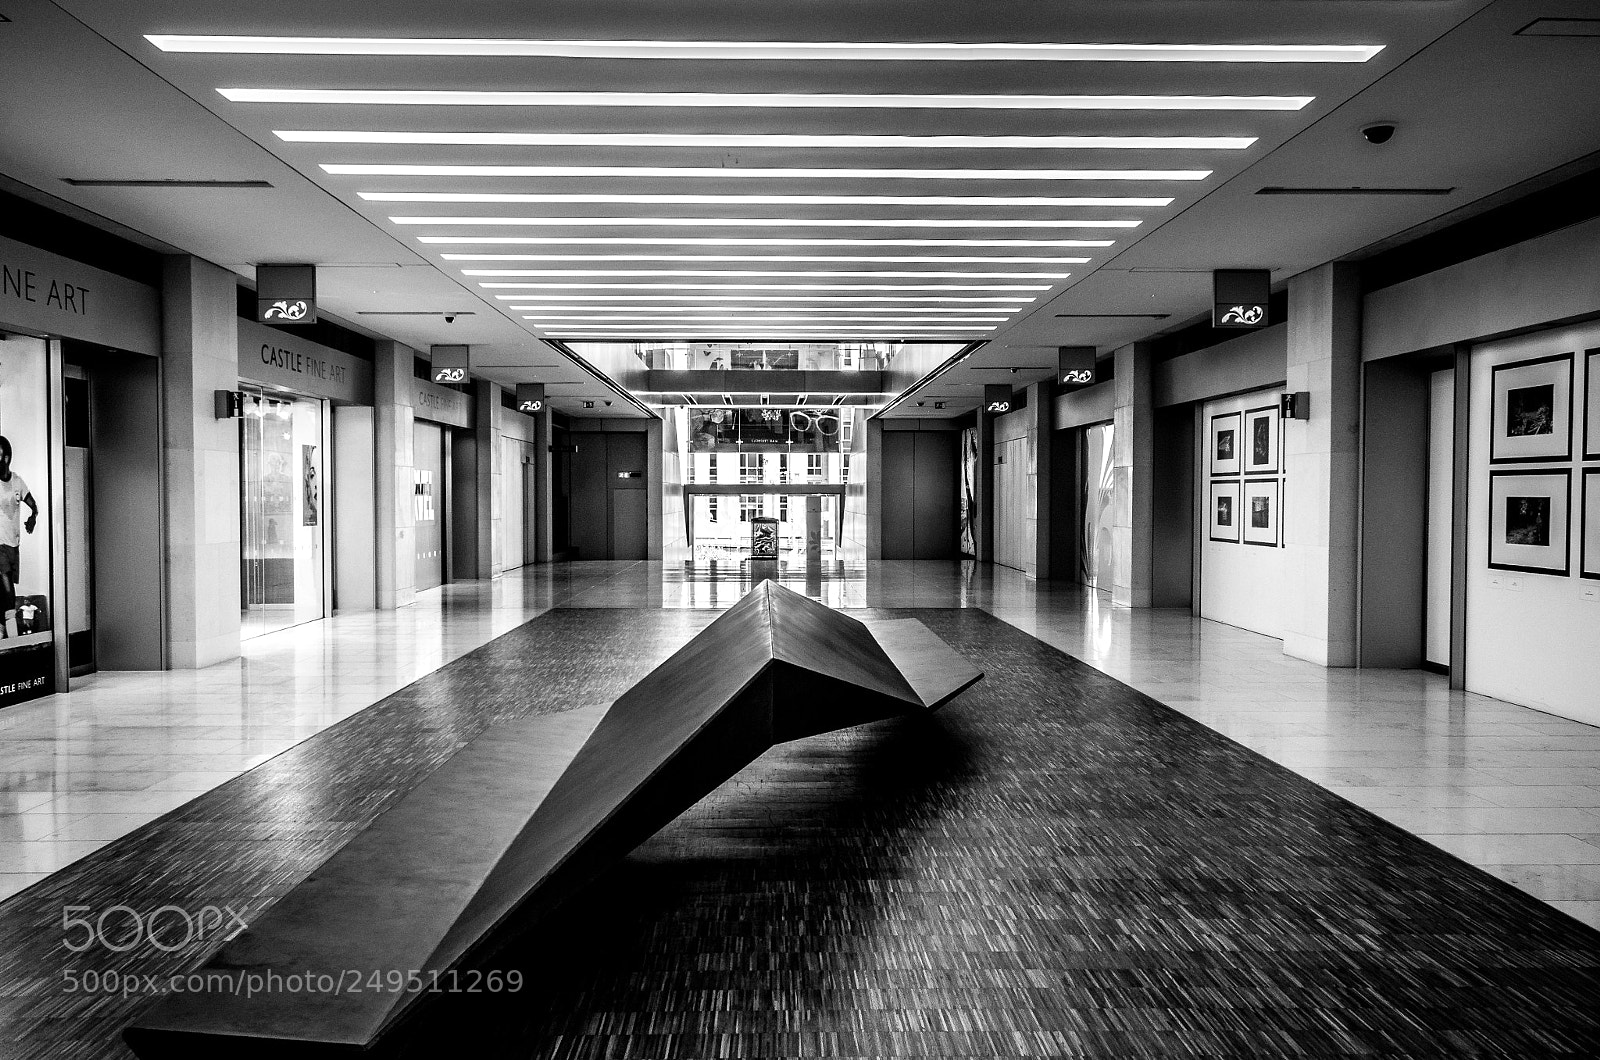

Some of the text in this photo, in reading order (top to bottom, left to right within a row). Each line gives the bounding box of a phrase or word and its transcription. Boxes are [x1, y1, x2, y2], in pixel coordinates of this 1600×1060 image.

[3, 264, 90, 315] NE ART
[261, 344, 346, 385] CASTLE FINE ART
[17, 679, 32, 691] FINE
[33, 676, 45, 687] ART
